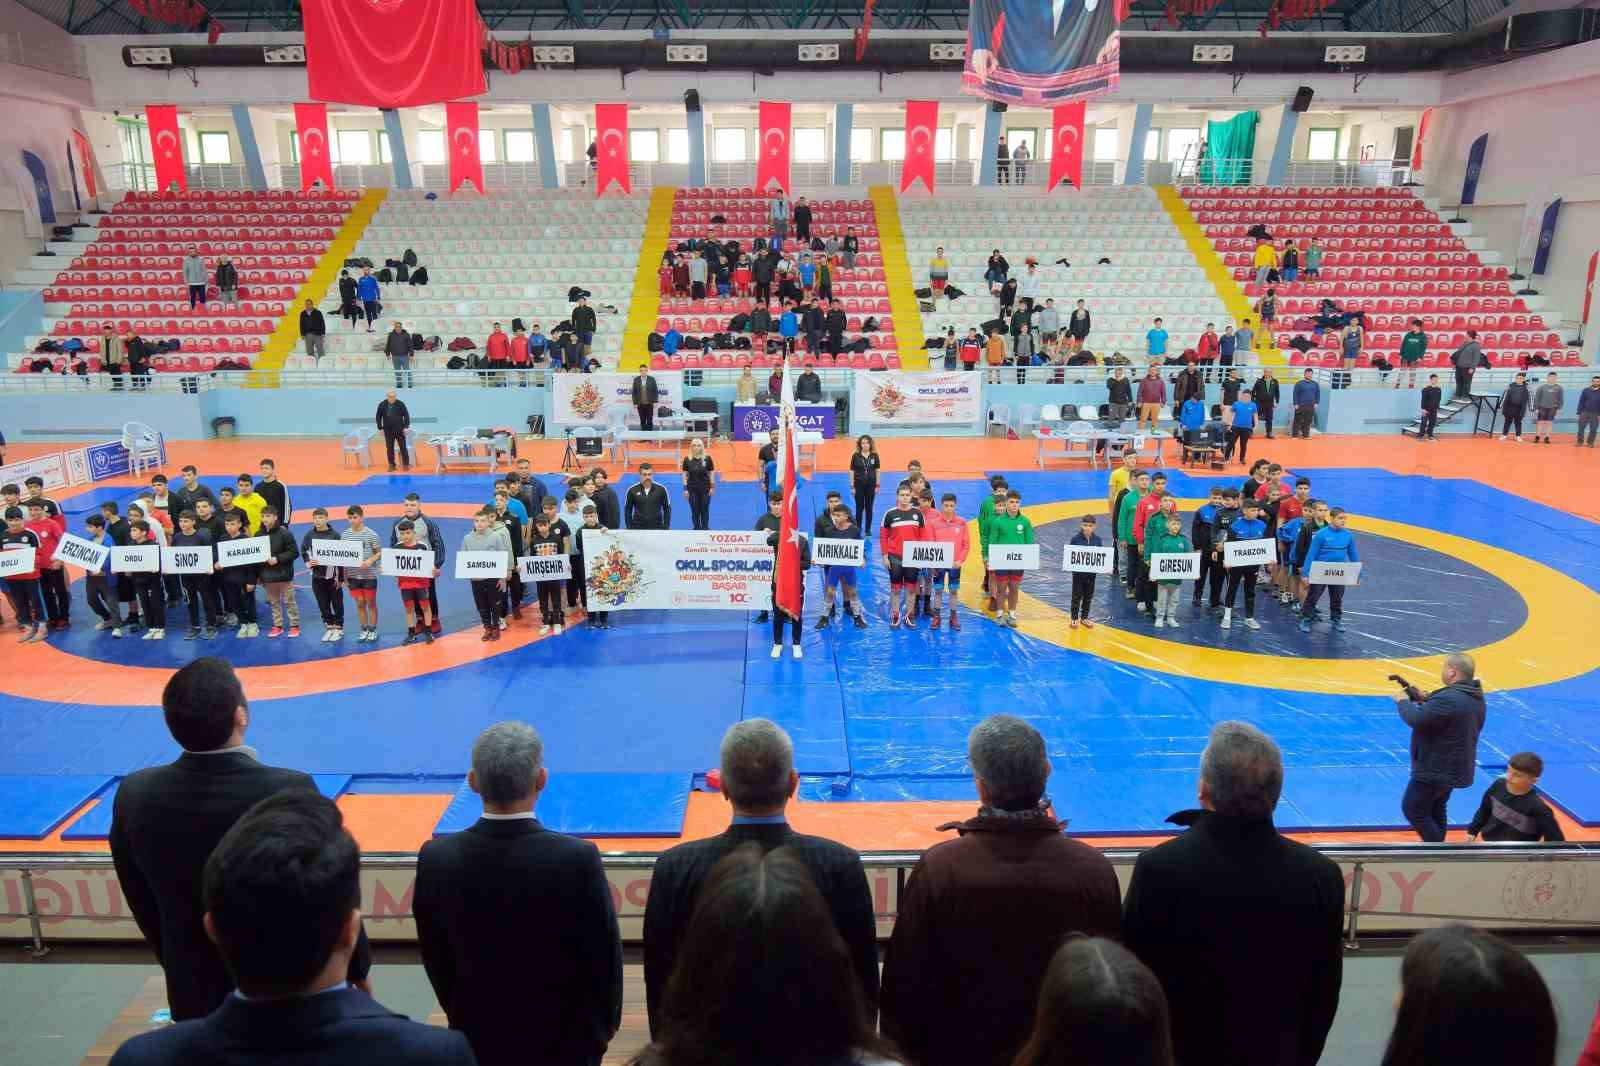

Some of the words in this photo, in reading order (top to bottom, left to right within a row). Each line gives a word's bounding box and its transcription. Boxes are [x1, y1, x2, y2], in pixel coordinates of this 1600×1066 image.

[709, 534, 752, 543] YOZGAT
[316, 549, 359, 559] KASTAMONU
[817, 546, 859, 560] KIRIKKALE
[912, 547, 944, 562] AMASYA
[1233, 547, 1266, 558] TRABZON
[395, 555, 422, 571] TOKAT
[466, 560, 497, 569] SAMSUN
[1070, 551, 1106, 567] BAYBURT
[675, 560, 710, 571] OKUL
[711, 560, 773, 571] SPORLARI
